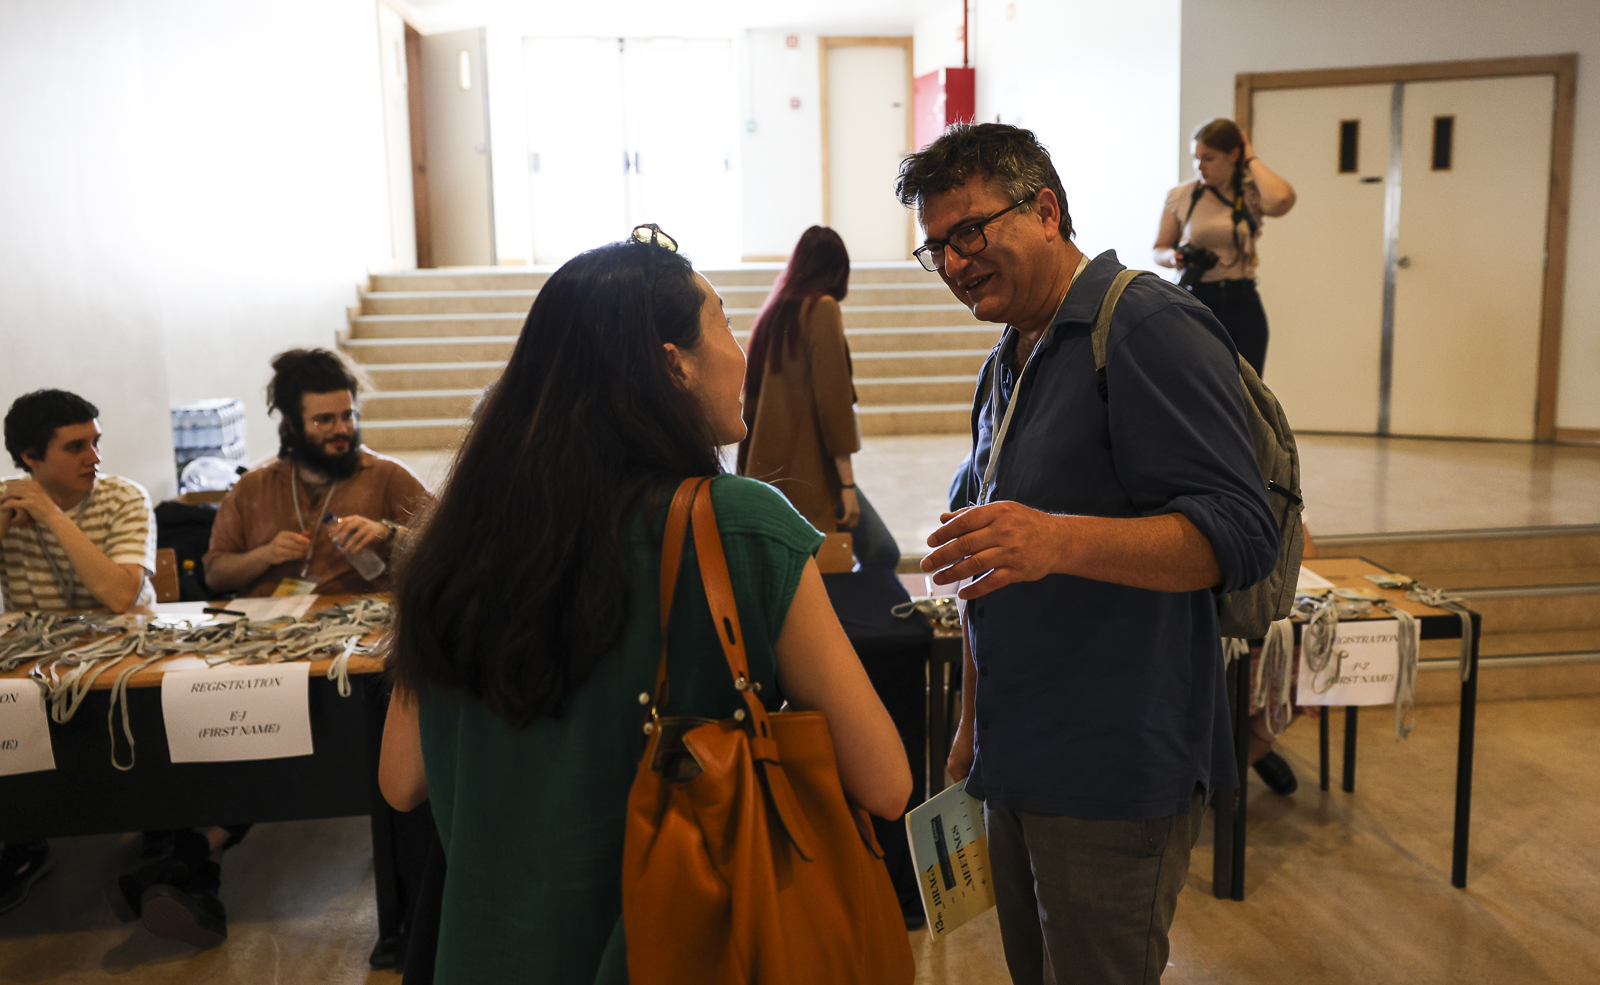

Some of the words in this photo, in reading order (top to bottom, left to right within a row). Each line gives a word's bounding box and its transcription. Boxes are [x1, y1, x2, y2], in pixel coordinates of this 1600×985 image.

[190, 676, 283, 693] REGISTRATION
[229, 710, 247, 722] E-J
[198, 725, 239, 739] (FIRST
[239, 723, 280, 736] NAME)
[951, 825, 973, 886] MEETINGS
[927, 864, 942, 907] BRAGA
